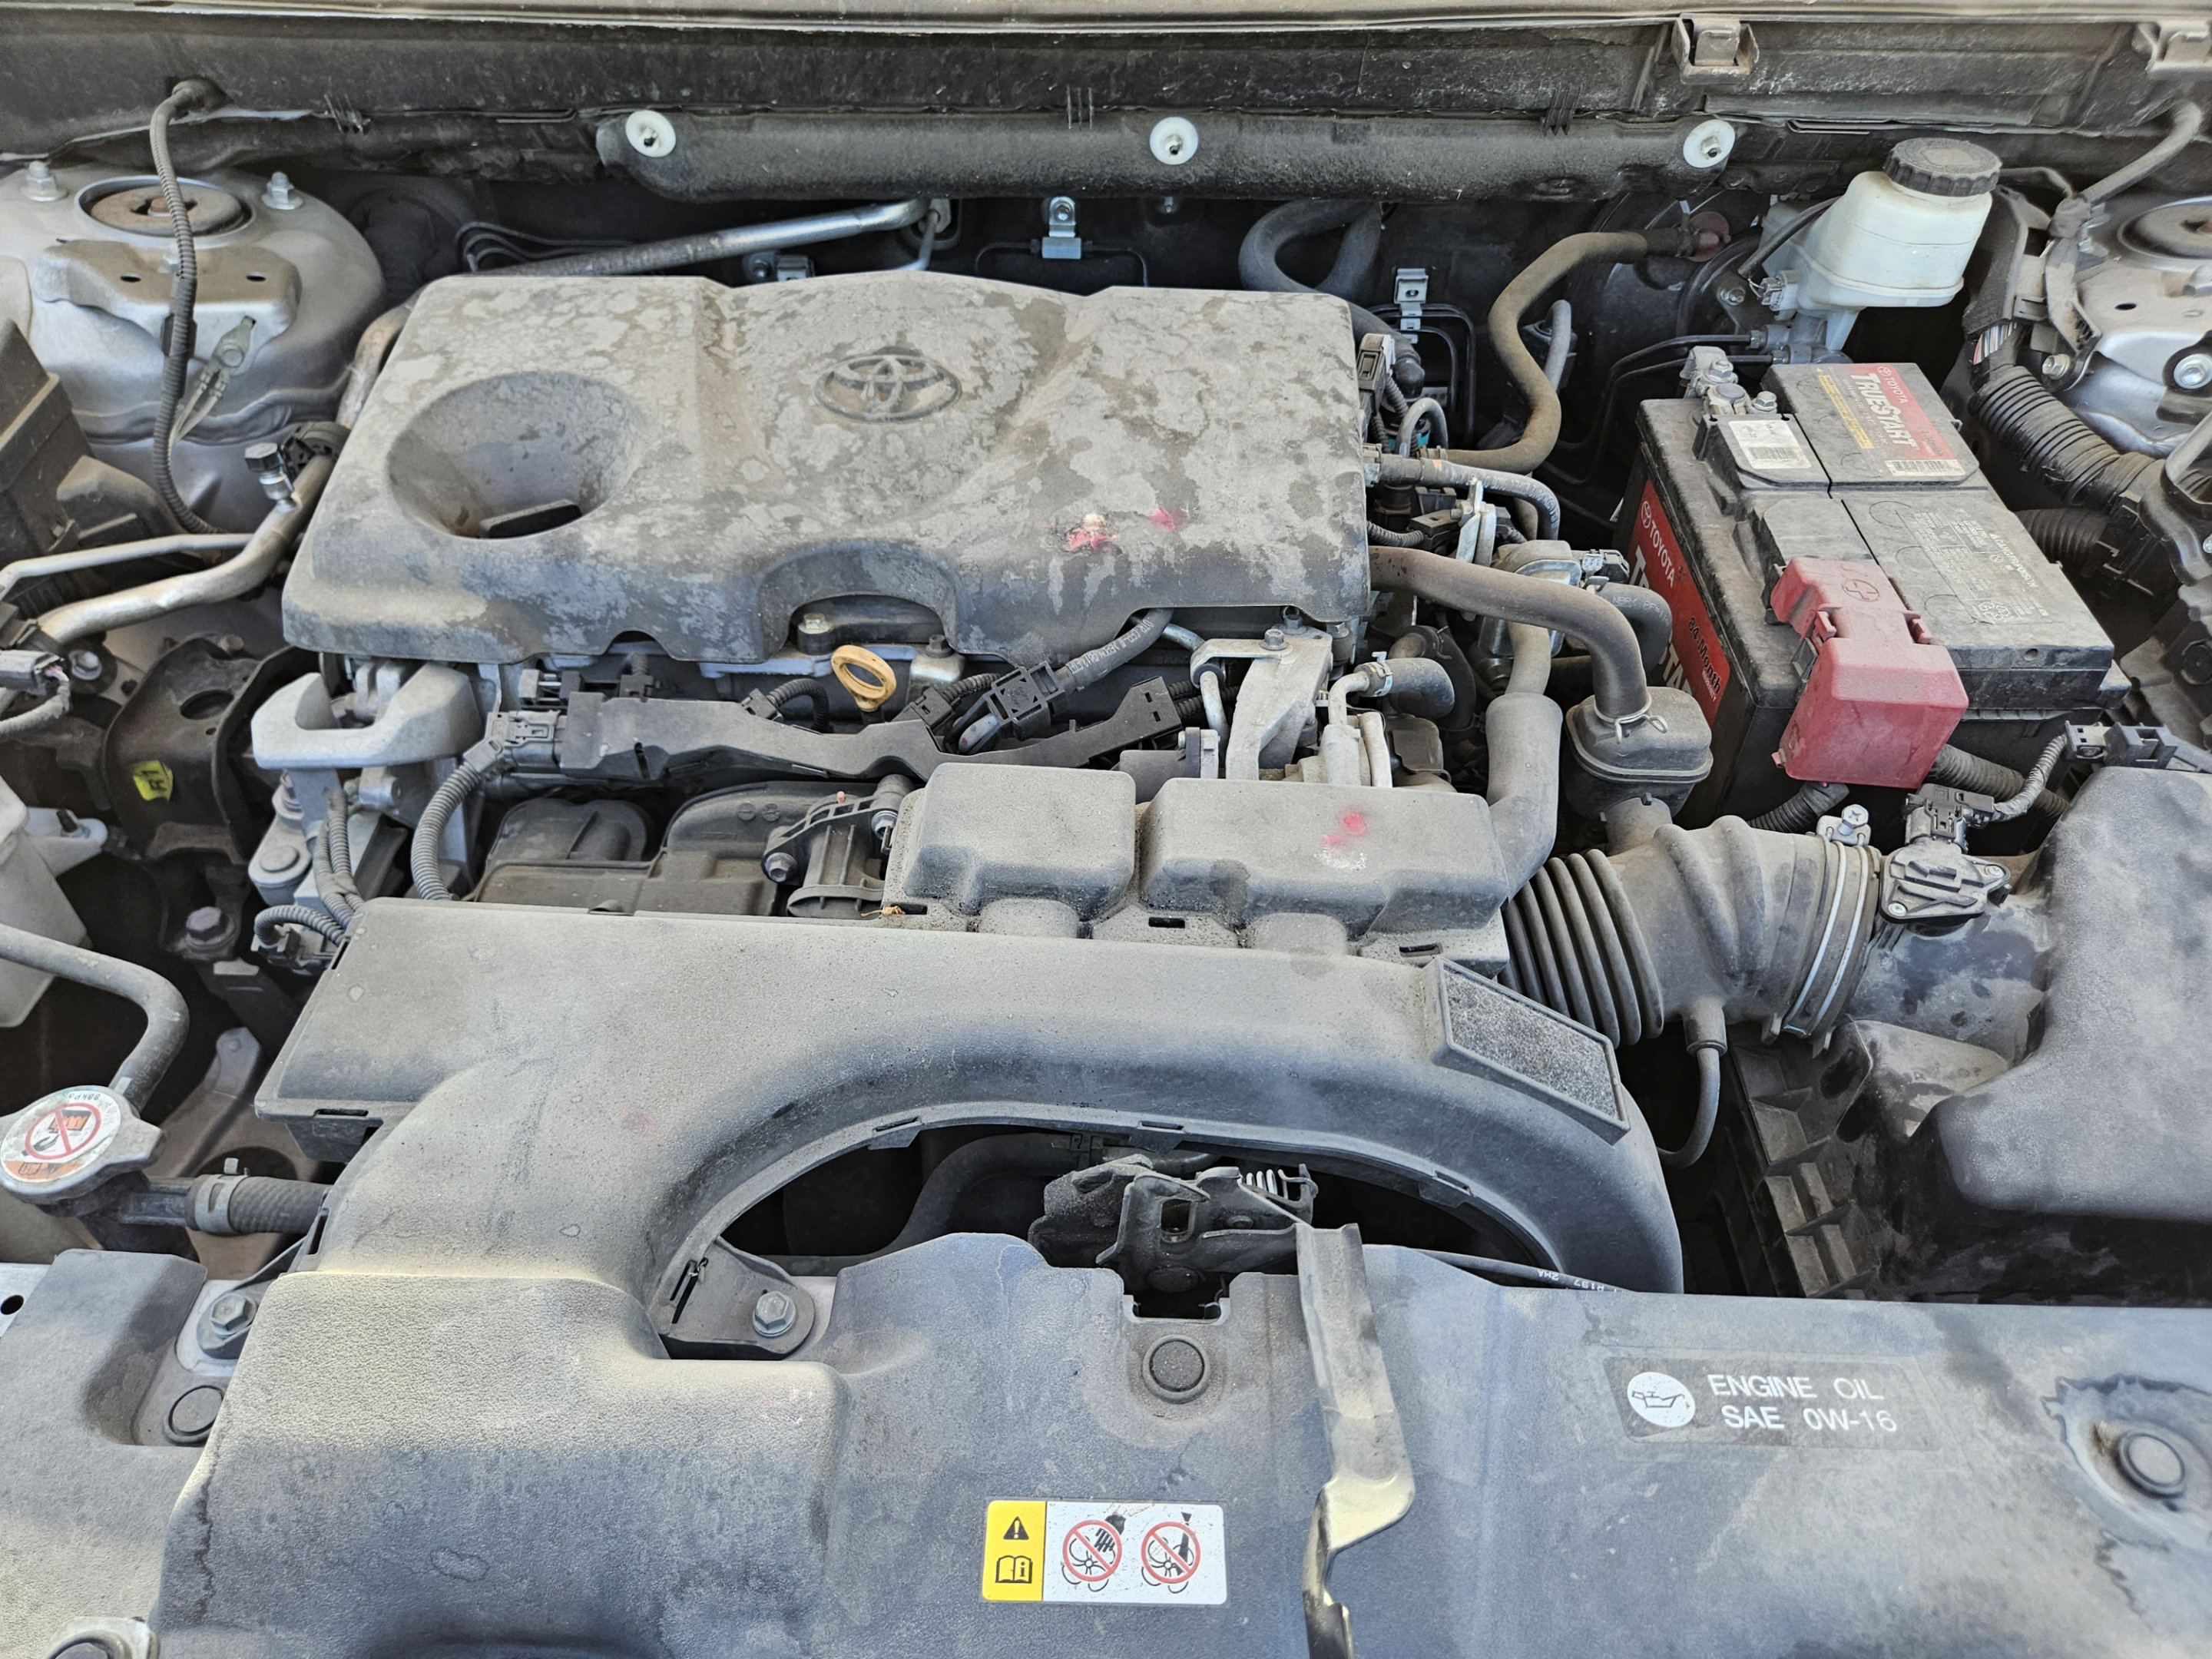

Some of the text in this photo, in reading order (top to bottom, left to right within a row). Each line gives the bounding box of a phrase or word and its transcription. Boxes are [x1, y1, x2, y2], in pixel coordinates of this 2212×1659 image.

[1885, 377, 1909, 404] TOYOTA
[1650, 520, 1675, 588] TOYOTA
[1707, 1374, 1884, 1399] ENGINE OIL
[1721, 1405, 1897, 1432] SAE 0W-16
